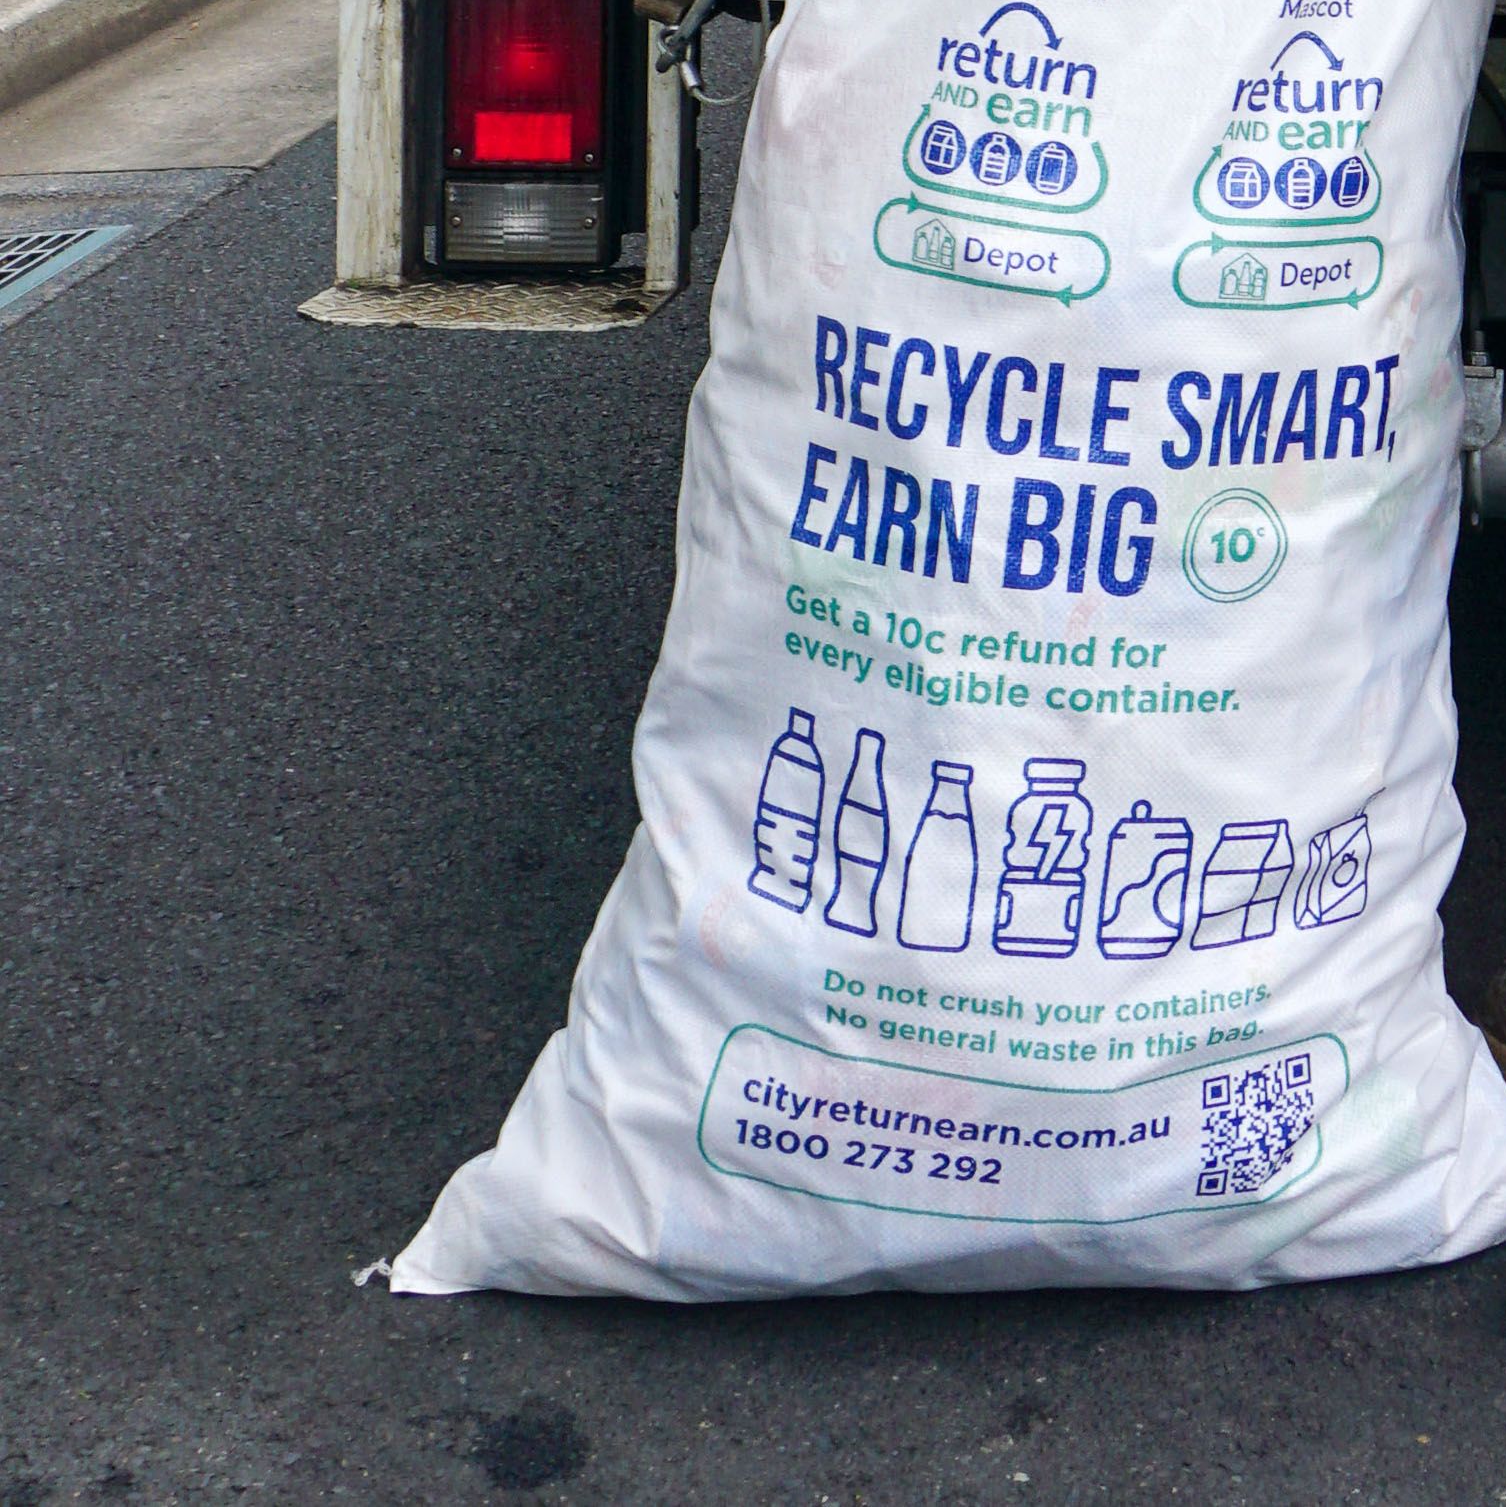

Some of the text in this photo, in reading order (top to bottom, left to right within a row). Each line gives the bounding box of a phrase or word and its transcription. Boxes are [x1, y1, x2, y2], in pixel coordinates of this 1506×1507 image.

[937, 33, 1097, 100] return
[1231, 70, 1383, 114] return
[930, 80, 1092, 137] AND earn
[1222, 120, 1269, 142] AND
[962, 236, 1059, 278] Depot
[1279, 257, 1353, 290] Depot
[815, 314, 1400, 470] RECYCLE SMART,
[789, 441, 1158, 598] EARN BIG
[786, 584, 1166, 668] Get a 10c refund for
[785, 629, 1241, 715] every eligible container.
[823, 968, 1272, 1026] Do not crush your containers.
[826, 1003, 1265, 1063] No general waste in this bag.
[743, 1076, 1171, 1149] cityreturnearn.com.au
[735, 1118, 1003, 1186] 1800 273 292
